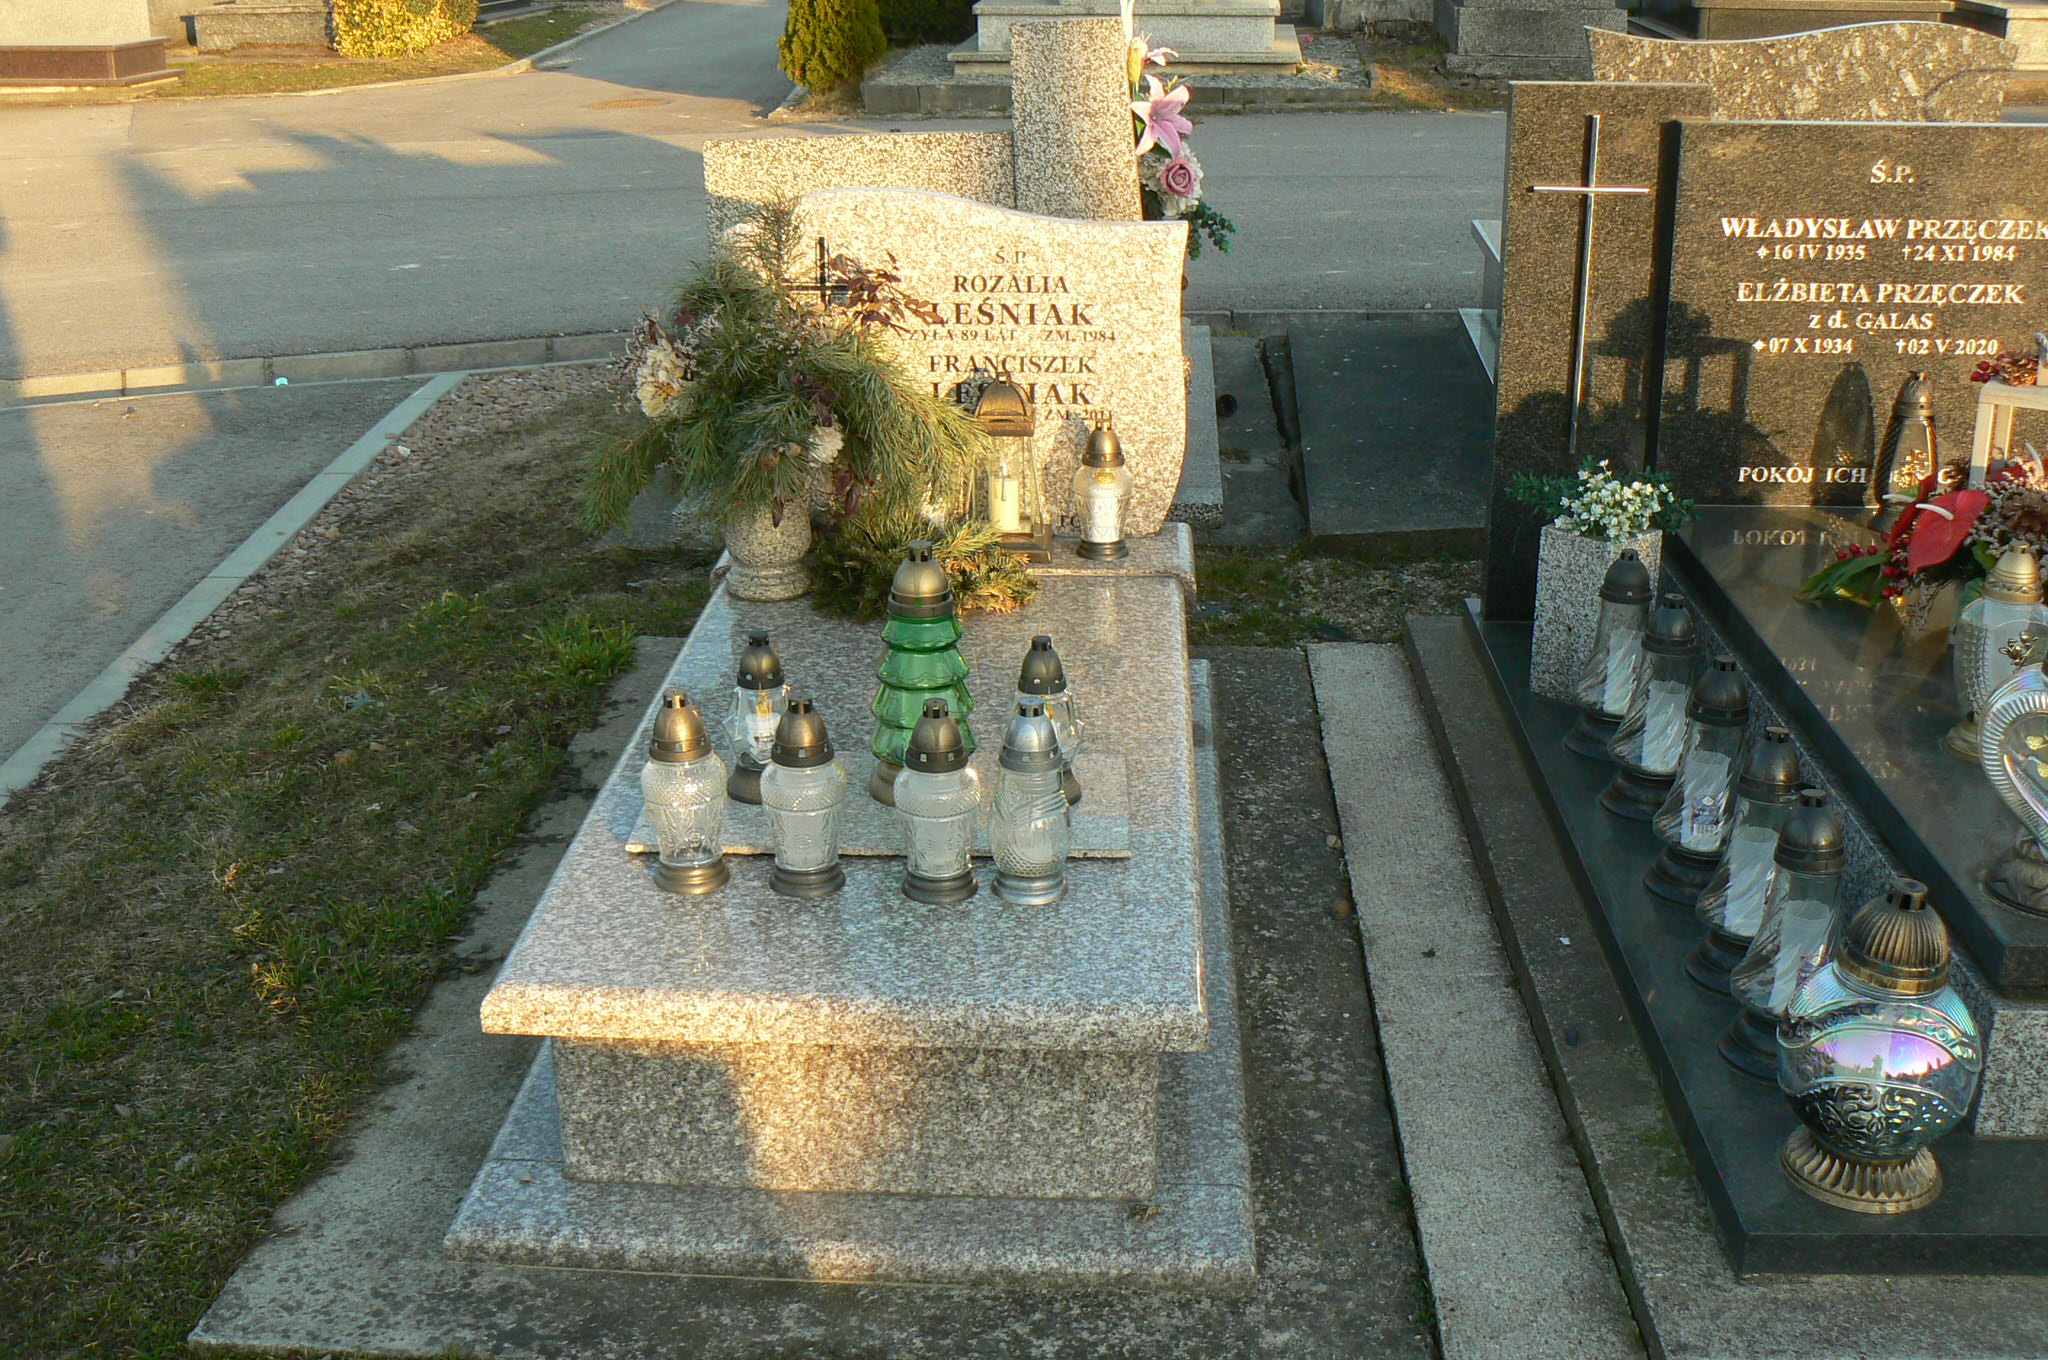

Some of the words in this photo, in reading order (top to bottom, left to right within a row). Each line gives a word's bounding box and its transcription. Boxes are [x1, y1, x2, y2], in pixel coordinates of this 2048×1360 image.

[1721, 217, 1901, 239] WŁADYSŁAW
[1906, 219, 2048, 245] PRZĘCZEK
[1774, 244, 1793, 260] 16
[1799, 244, 1821, 260] IV
[1825, 244, 1867, 261] 1935
[1913, 244, 1936, 261] 24
[1940, 245, 1967, 261] XI
[1971, 245, 2017, 261] 1984
[953, 275, 1069, 293] ROZALIA
[1736, 277, 1871, 303] ELŻBIETA
[1876, 283, 2025, 306] PRZĘCZEK
[931, 297, 1093, 325] LEŚNIAK
[961, 329, 978, 342] 89
[1769, 338, 1790, 353] 07
[1793, 338, 1809, 353] X
[1814, 338, 1854, 353] 1934
[1907, 339, 1930, 355] 02
[1934, 339, 1951, 354] V
[1954, 338, 1999, 355] 2020
[929, 355, 1094, 374] FRANCISZEK
[1738, 462, 1815, 484] POKÓJ
[1825, 466, 1867, 484] ICH
